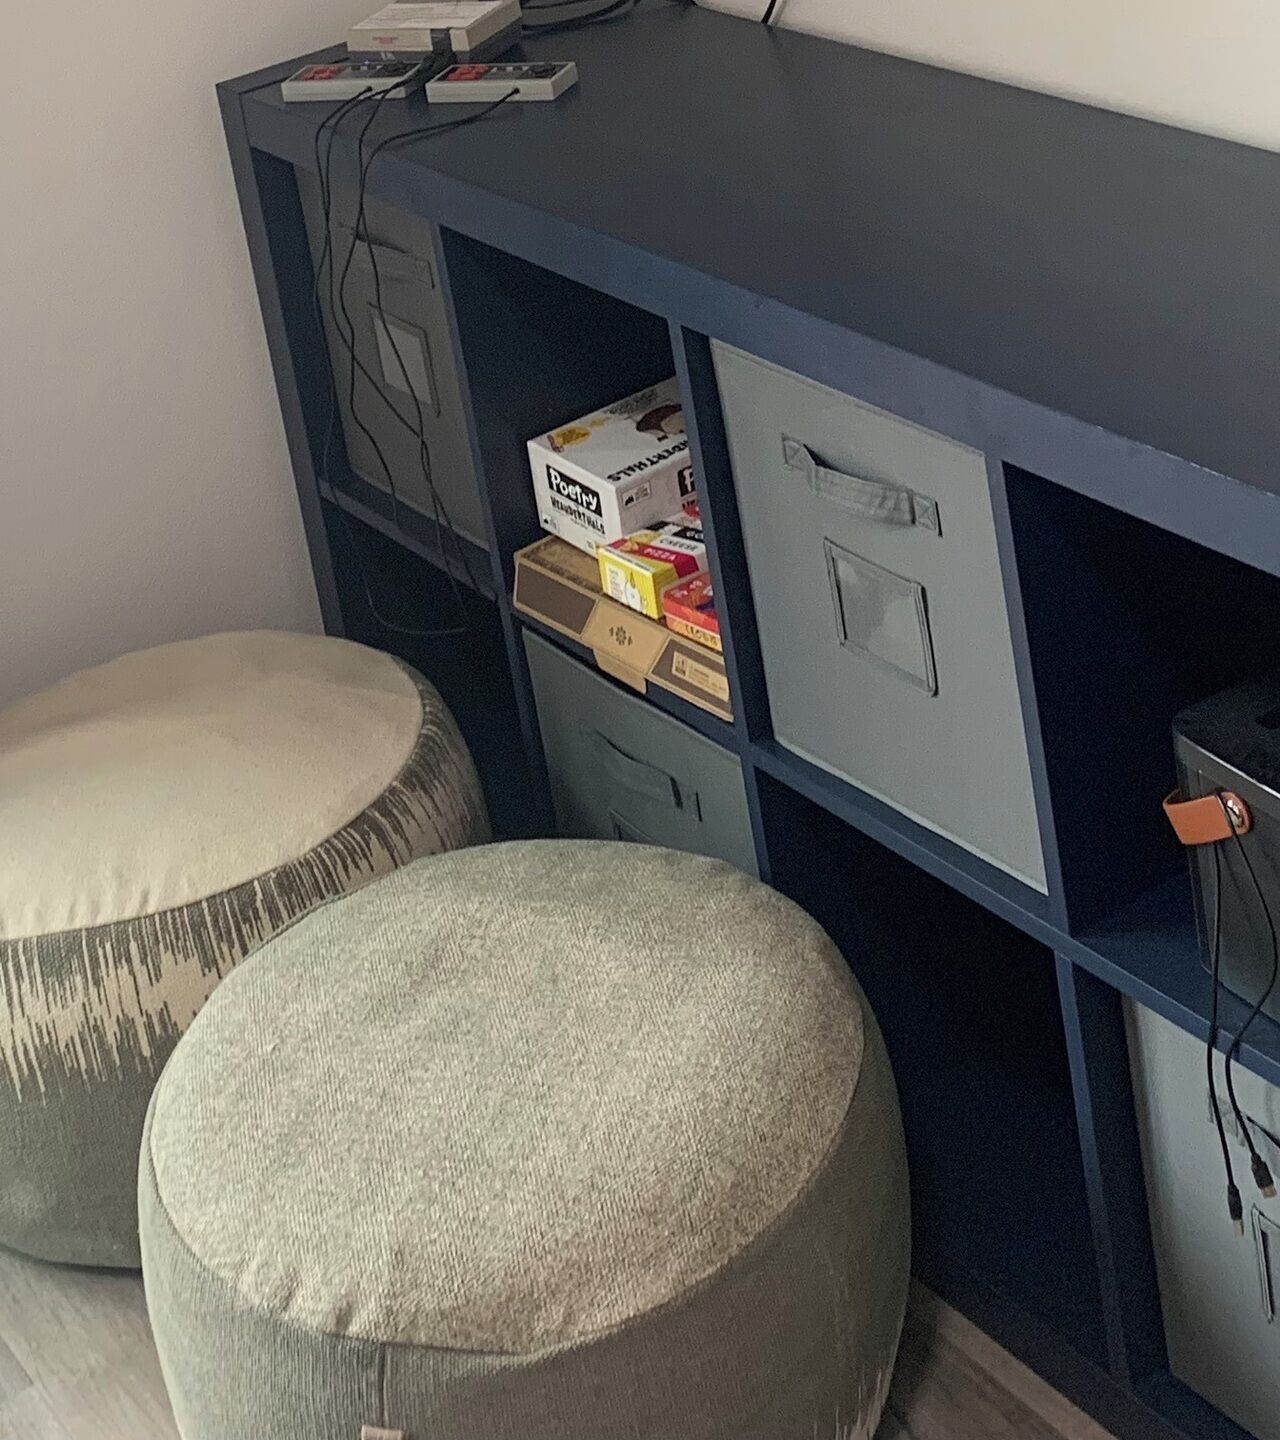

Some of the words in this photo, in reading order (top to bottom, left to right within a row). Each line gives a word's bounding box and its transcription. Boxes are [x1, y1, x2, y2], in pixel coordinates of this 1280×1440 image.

[549, 467, 598, 511] Poetry
[659, 538, 698, 551] CHEESE
[643, 548, 677, 562] PIZZA
